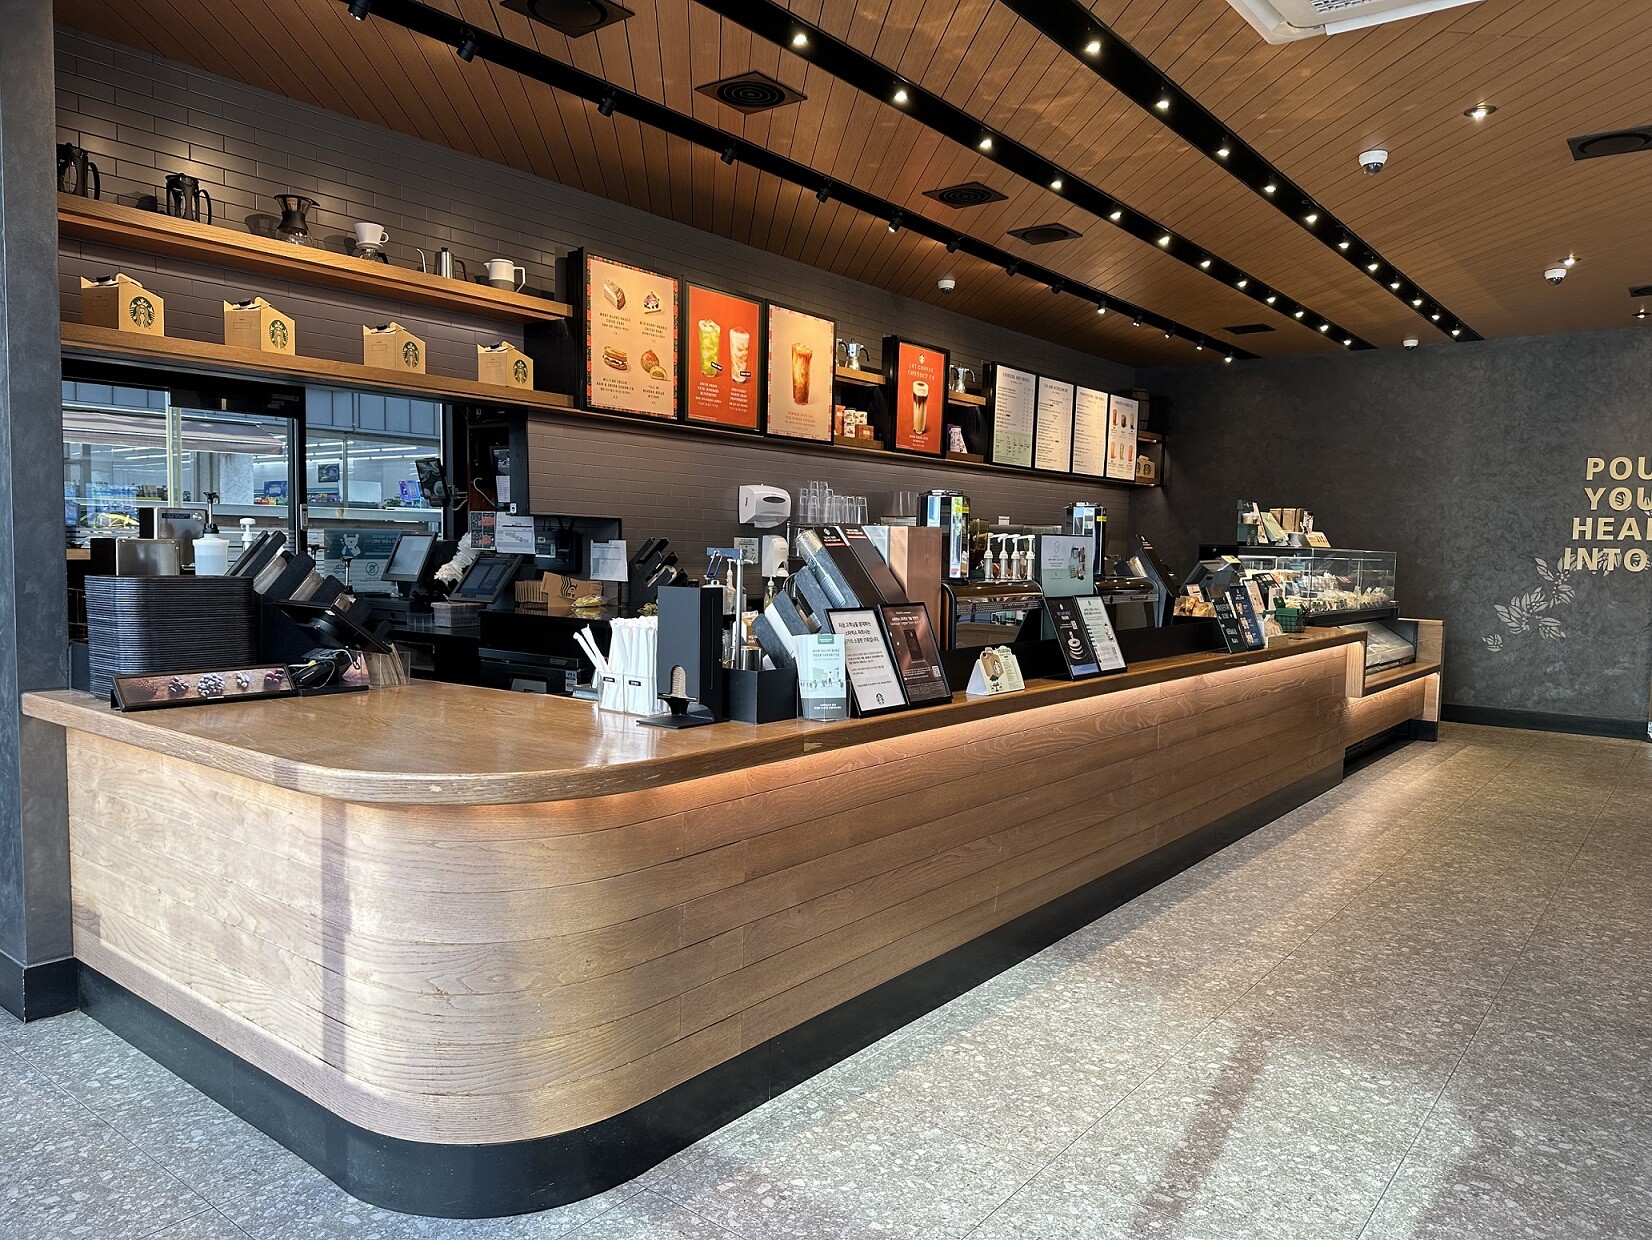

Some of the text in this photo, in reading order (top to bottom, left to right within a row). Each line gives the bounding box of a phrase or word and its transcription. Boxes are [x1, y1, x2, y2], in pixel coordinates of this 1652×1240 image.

[1586, 456, 1652, 480] POU
[1584, 486, 1652, 511] YOU
[1563, 548, 1648, 572] INTO
